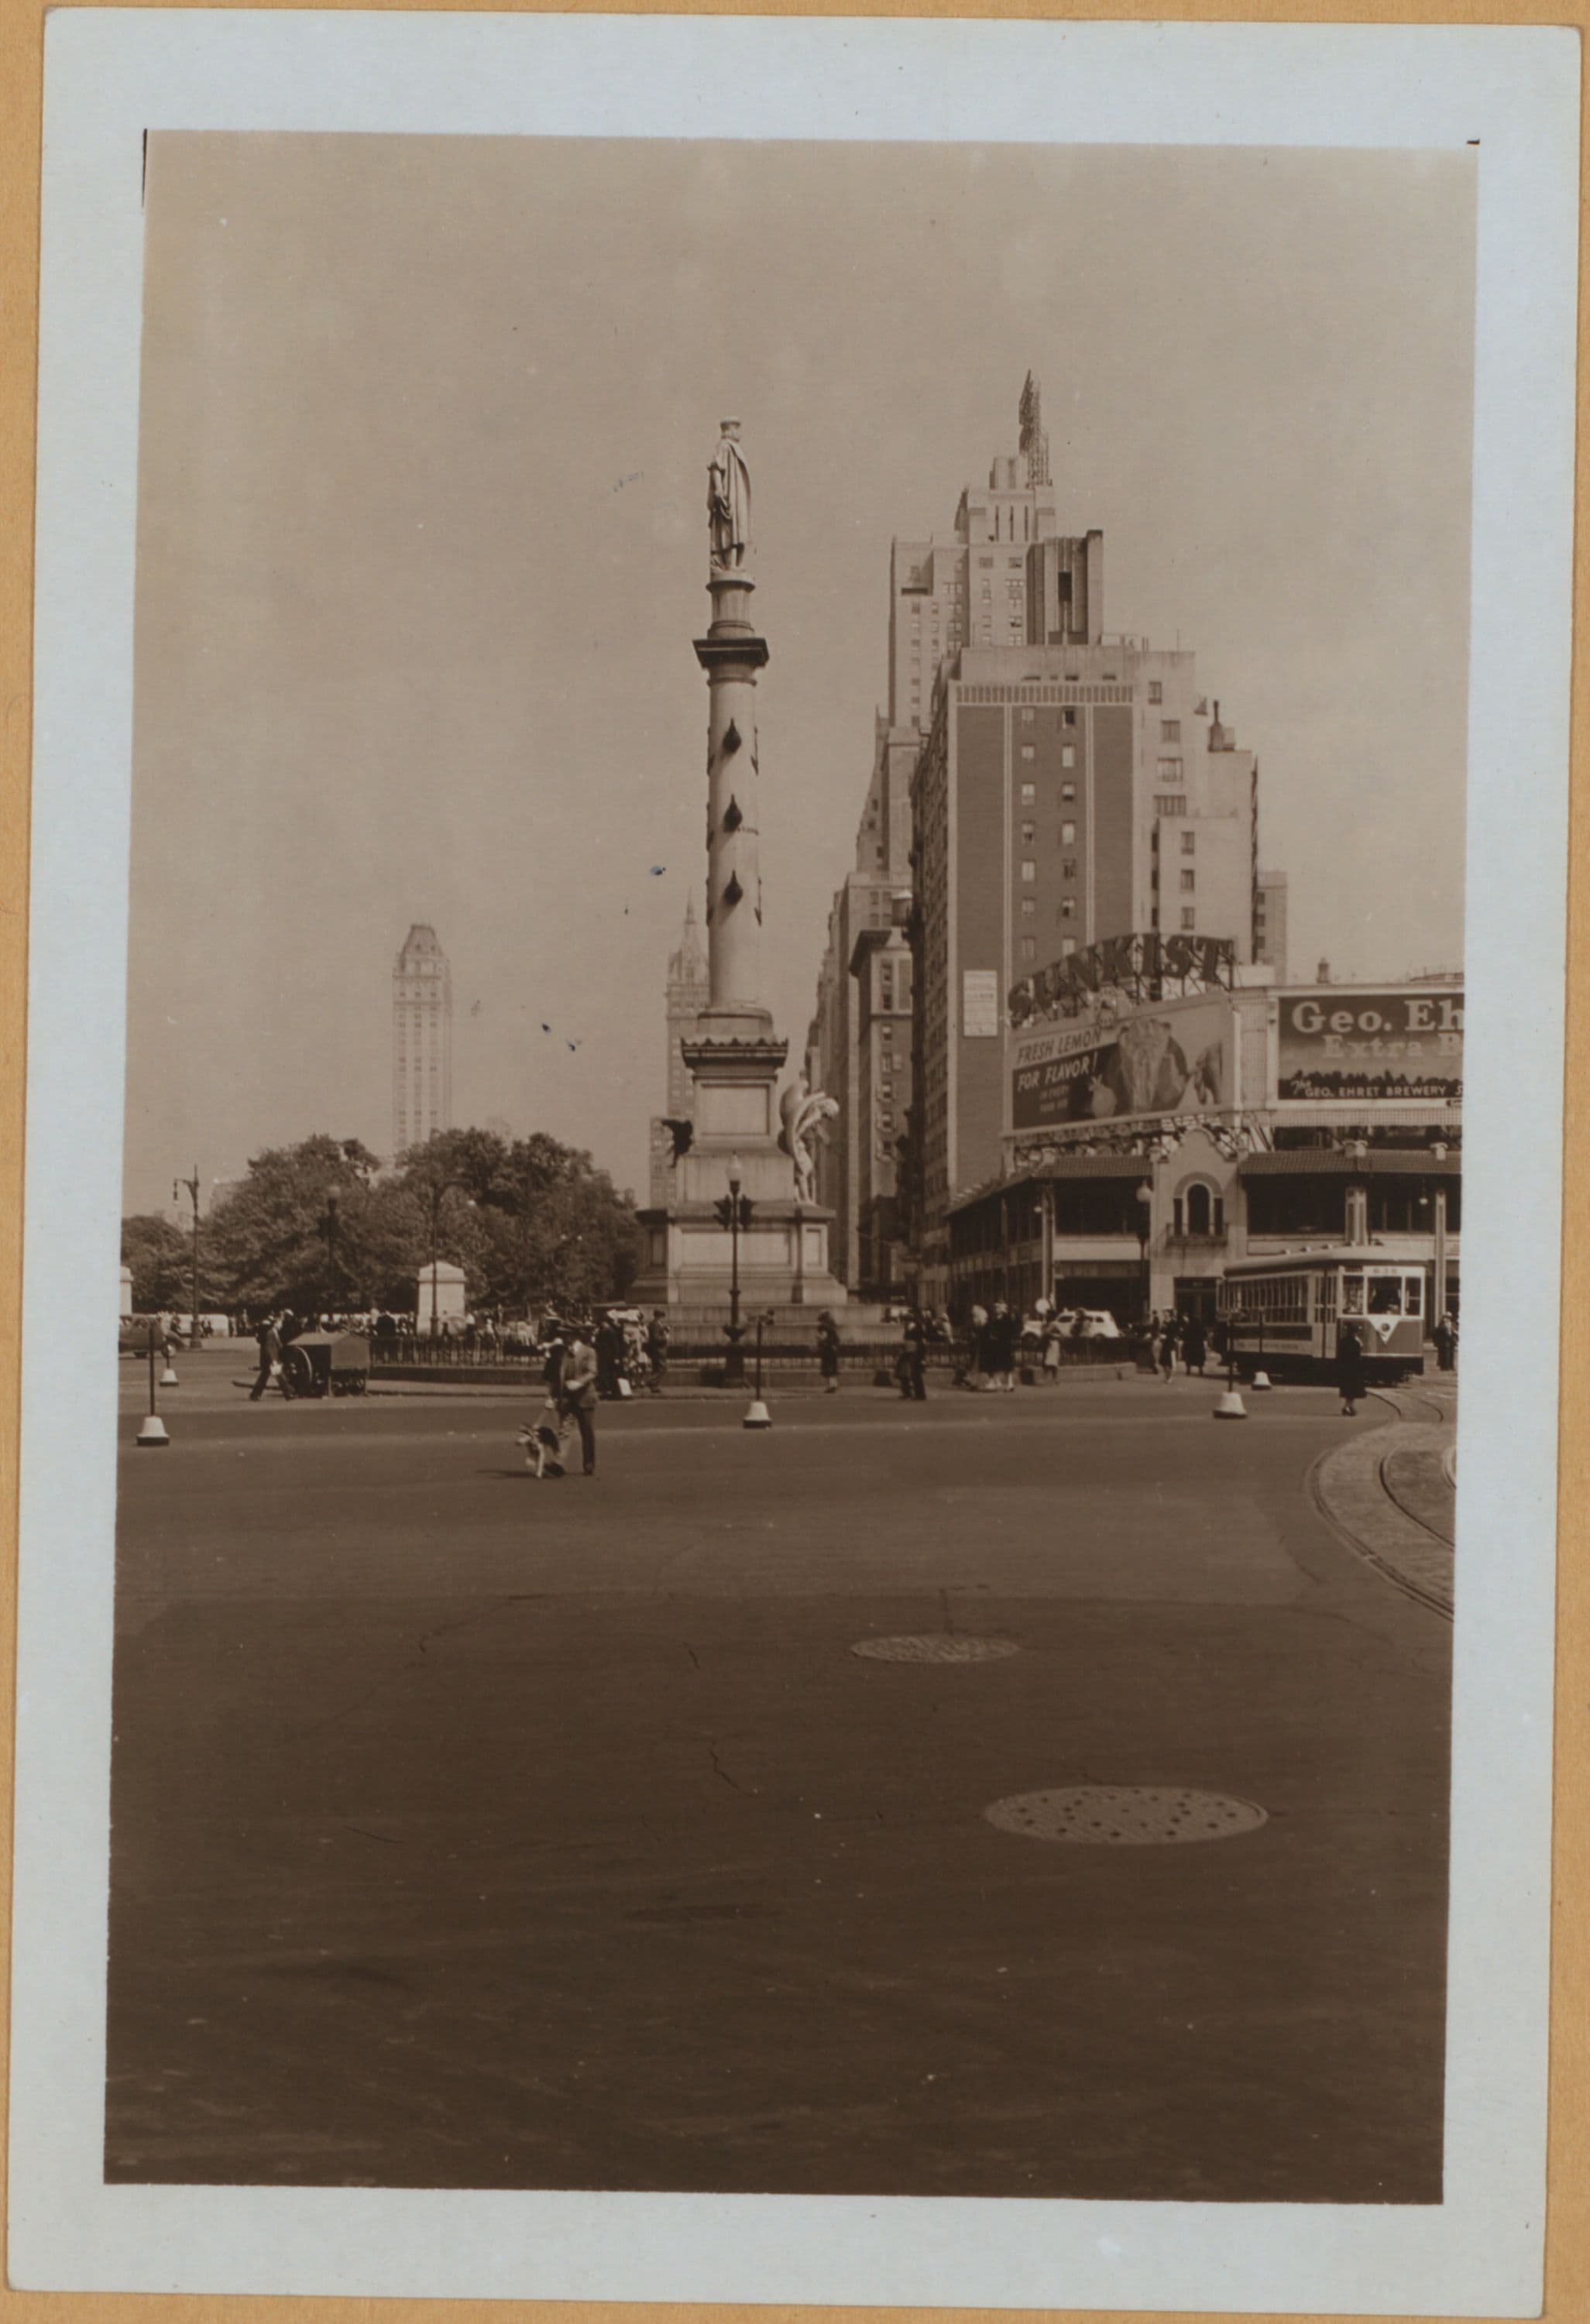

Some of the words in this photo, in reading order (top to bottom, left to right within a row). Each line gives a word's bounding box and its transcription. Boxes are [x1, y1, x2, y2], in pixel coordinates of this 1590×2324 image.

[1008, 933, 1233, 1028] SUNKIST
[1292, 1001, 1393, 1033] Geo.
[1016, 1038, 1055, 1064] FRESH
[1057, 1024, 1101, 1054] LEMON
[1322, 1034, 1424, 1058] Extra
[1017, 1070, 1040, 1093] FOR
[1305, 1086, 1334, 1097] GEO.
[1339, 1086, 1380, 1097] EHRET
[1386, 1085, 1447, 1097] BREWERY
